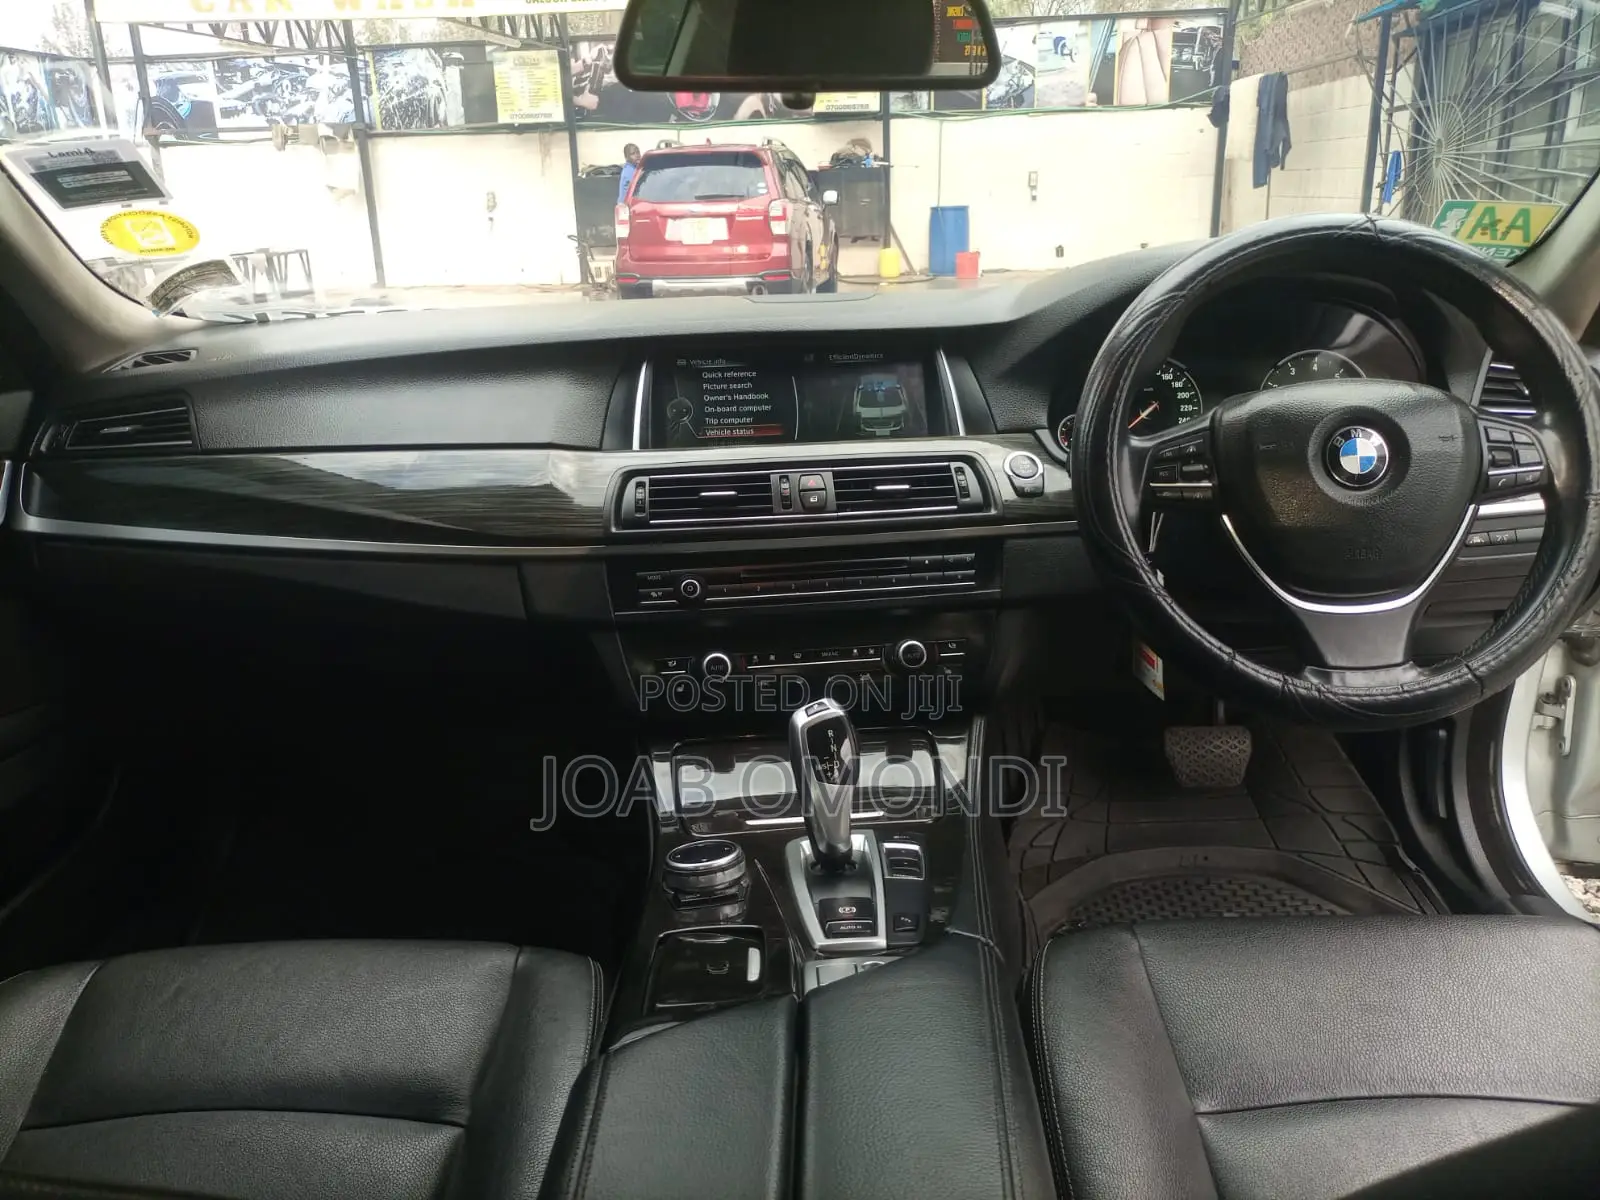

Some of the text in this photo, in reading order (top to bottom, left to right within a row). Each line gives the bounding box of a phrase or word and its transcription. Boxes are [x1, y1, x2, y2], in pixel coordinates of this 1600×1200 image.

[702, 370, 757, 379] Quick reference
[1290, 367, 1296, 376] 3
[1161, 373, 1173, 381] 160
[703, 394, 732, 402] Owner's
[1177, 391, 1190, 399] 200
[704, 404, 772, 413] On-board computer
[1180, 404, 1193, 412] 220
[705, 417, 719, 425] Trip
[1332, 428, 1384, 448] BMW
[828, 729, 834, 737] R
